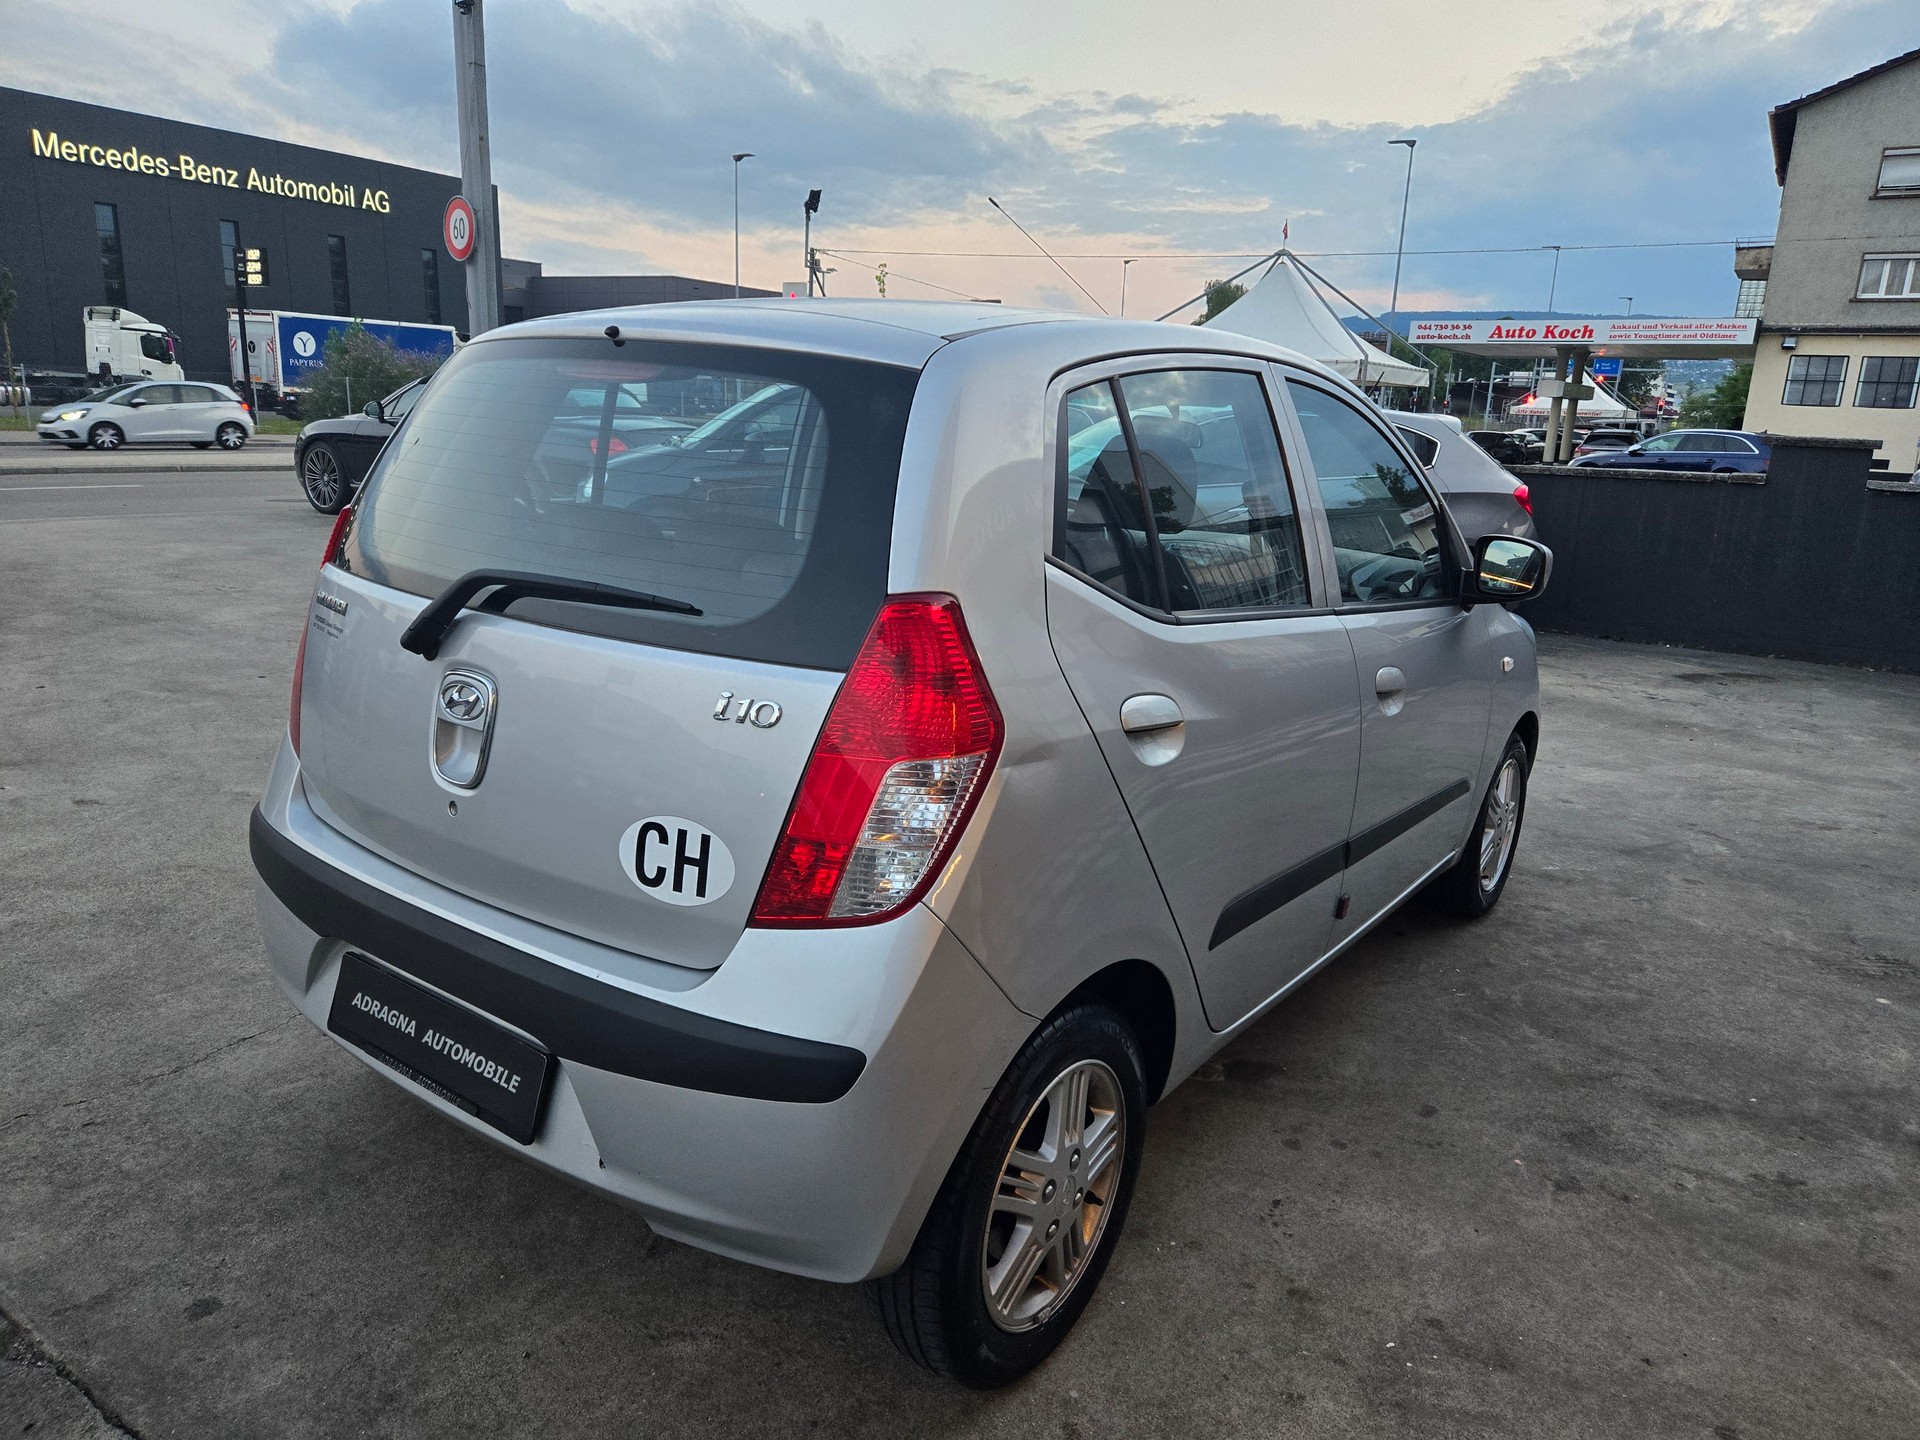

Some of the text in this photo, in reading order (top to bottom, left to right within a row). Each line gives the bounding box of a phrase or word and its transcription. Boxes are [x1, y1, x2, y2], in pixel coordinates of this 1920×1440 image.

[31, 128, 390, 213] Mercedes-Benz Automobil AG
[453, 217, 466, 239] 60
[1462, 323, 1473, 331] 36
[1489, 324, 1594, 339] Auto Koch
[289, 358, 324, 368] PAPYRUS
[713, 691, 783, 729] i10
[635, 821, 711, 898] CH
[352, 992, 521, 1093] ADRAGNA AUTOMOBILE
